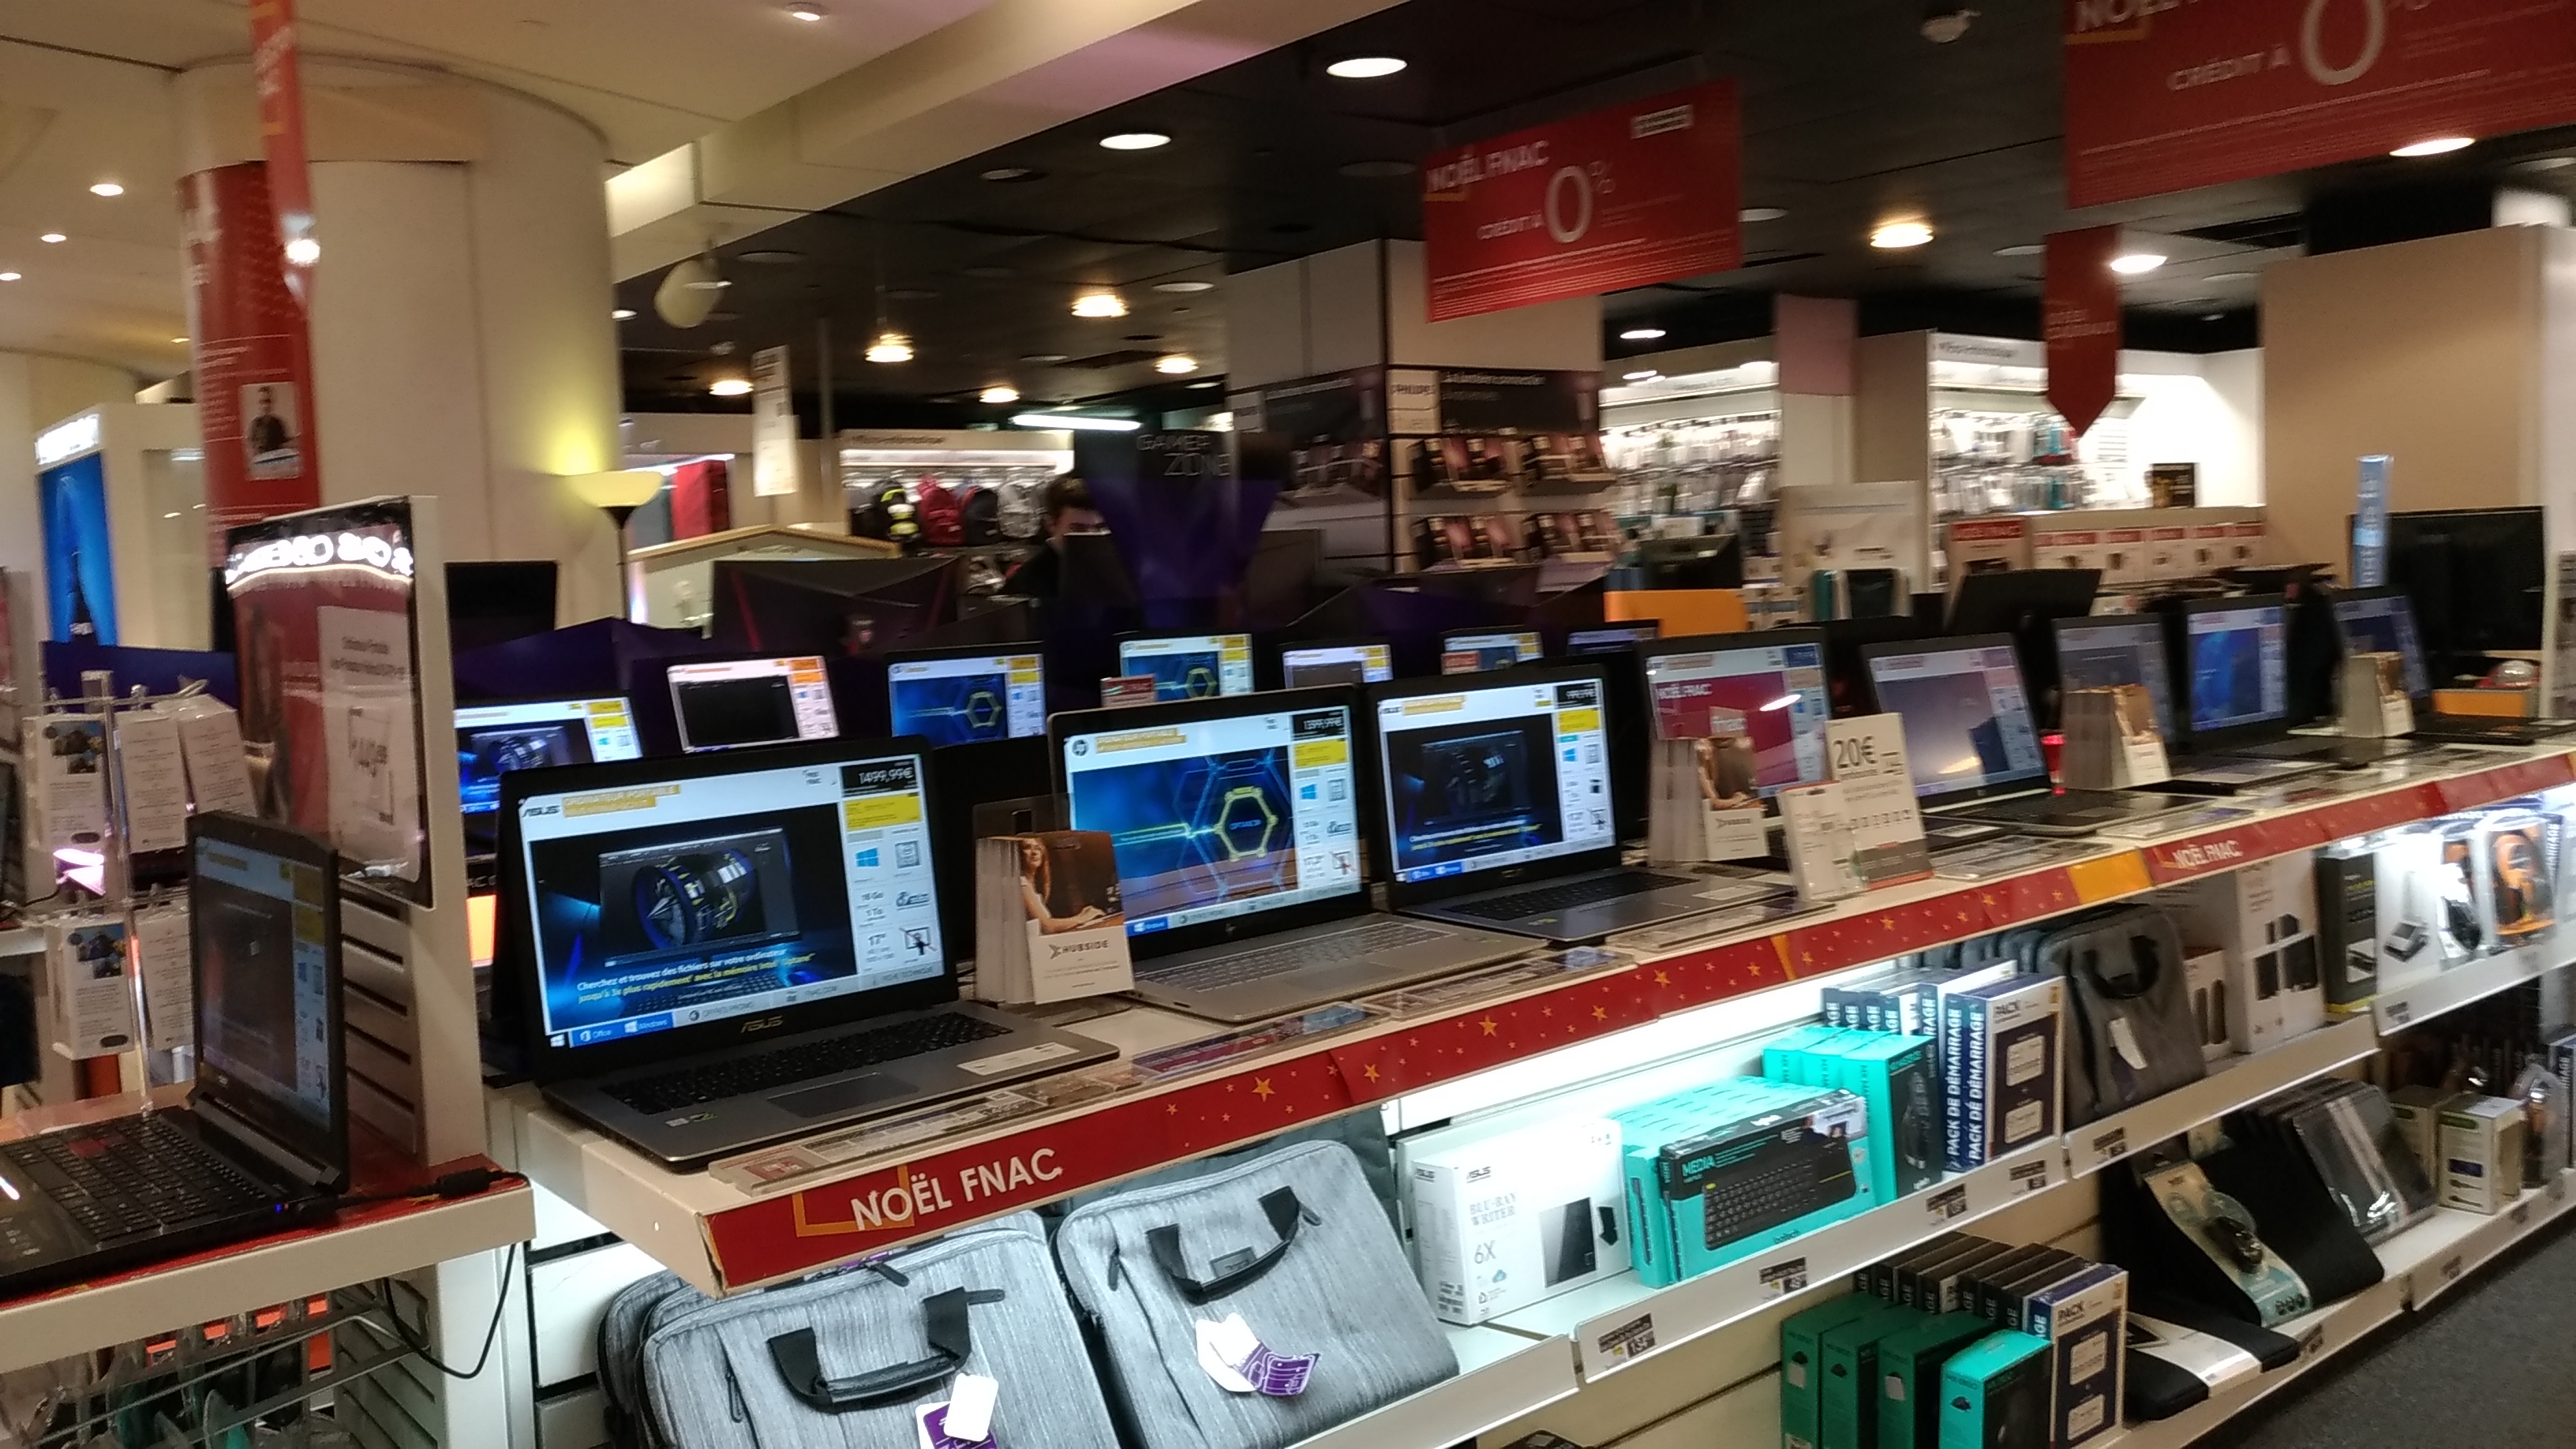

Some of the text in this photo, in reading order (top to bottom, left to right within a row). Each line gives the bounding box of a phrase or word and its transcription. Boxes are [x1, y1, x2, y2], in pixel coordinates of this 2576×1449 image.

[1833, 735, 1878, 769] 20€
[522, 805, 560, 818] ASUS
[577, 976, 618, 992] Cherchez
[662, 967, 677, 979] des
[740, 1015, 784, 1033] ASUS
[1967, 1012, 1984, 1099] DÉMARRAGE
[1945, 1009, 1962, 1156] PACK DE DÉMARRAGE
[1969, 1125, 1982, 1159] PACK
[1682, 1155, 1717, 1176] MEDIA
[851, 1148, 1065, 1230] NOËL FNAC
[1470, 1193, 1516, 1215] BLU-RAY
[1471, 1206, 1515, 1226] WRITER
[1474, 1240, 1496, 1264] 6X
